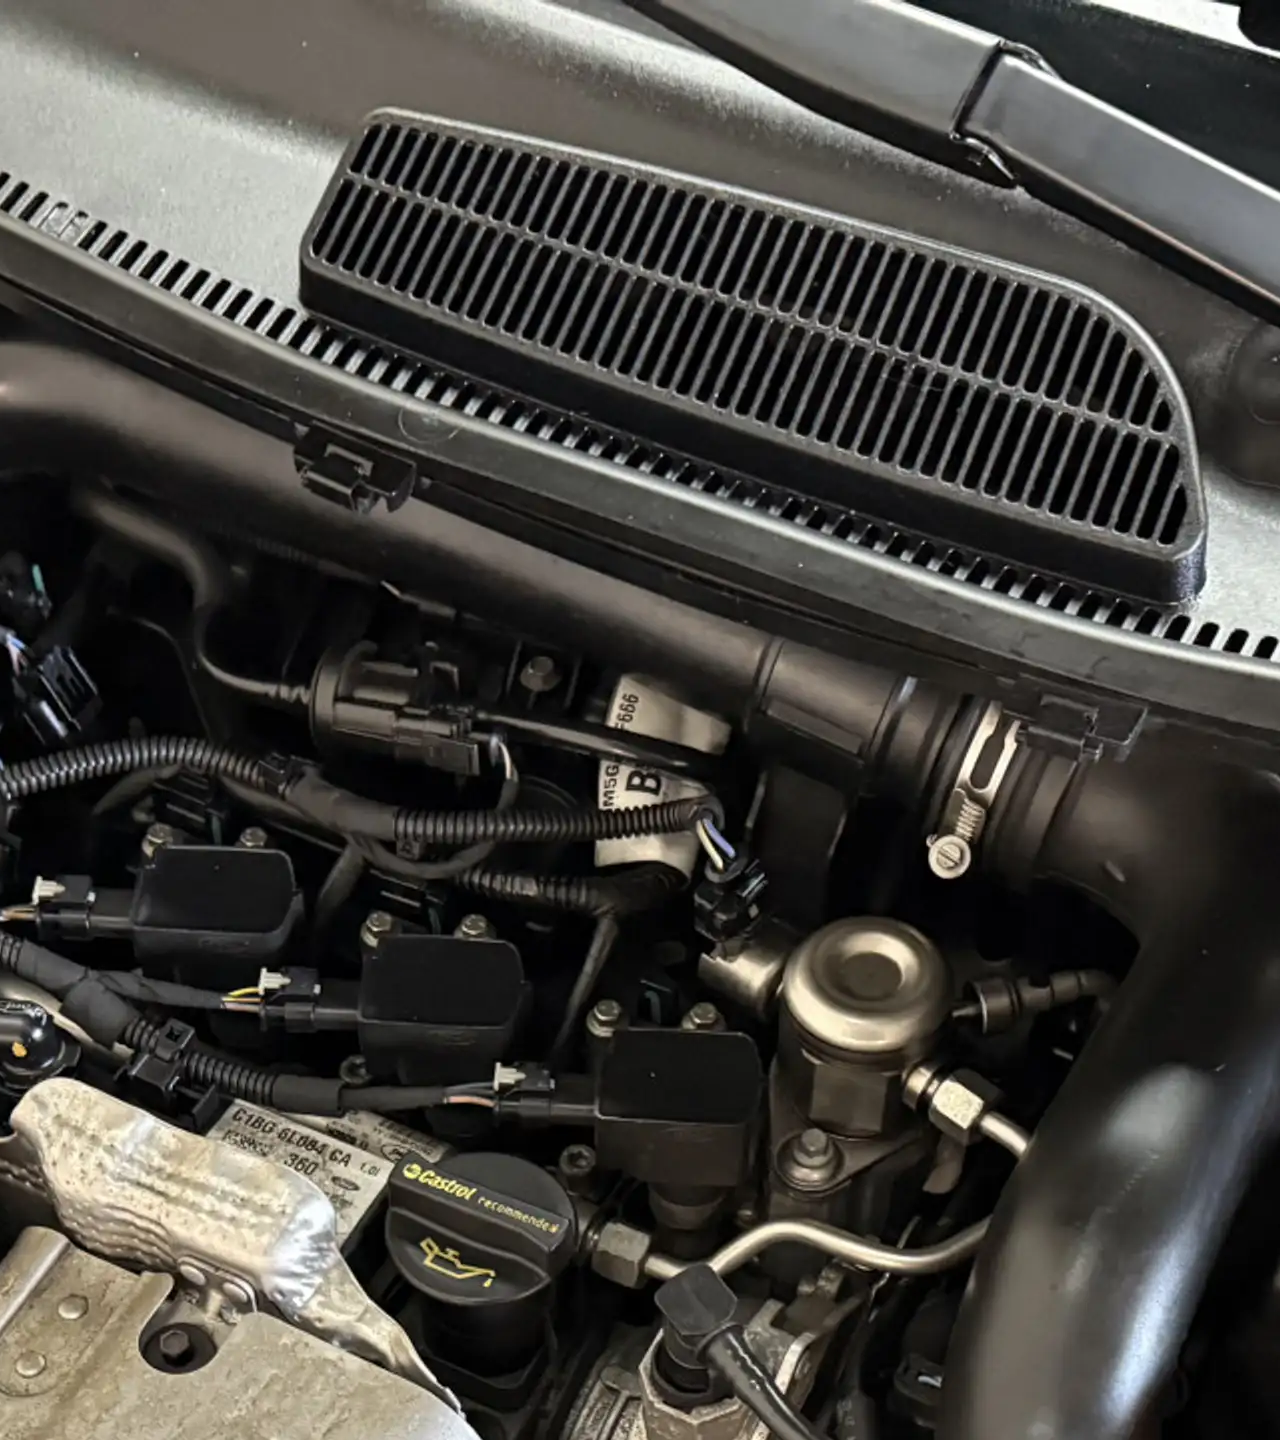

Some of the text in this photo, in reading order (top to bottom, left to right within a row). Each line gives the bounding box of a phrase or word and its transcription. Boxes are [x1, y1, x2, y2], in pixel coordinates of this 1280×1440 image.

[625, 770, 662, 796] B
[286, 1153, 320, 1176] 360
[418, 1170, 477, 1200] Castrol
